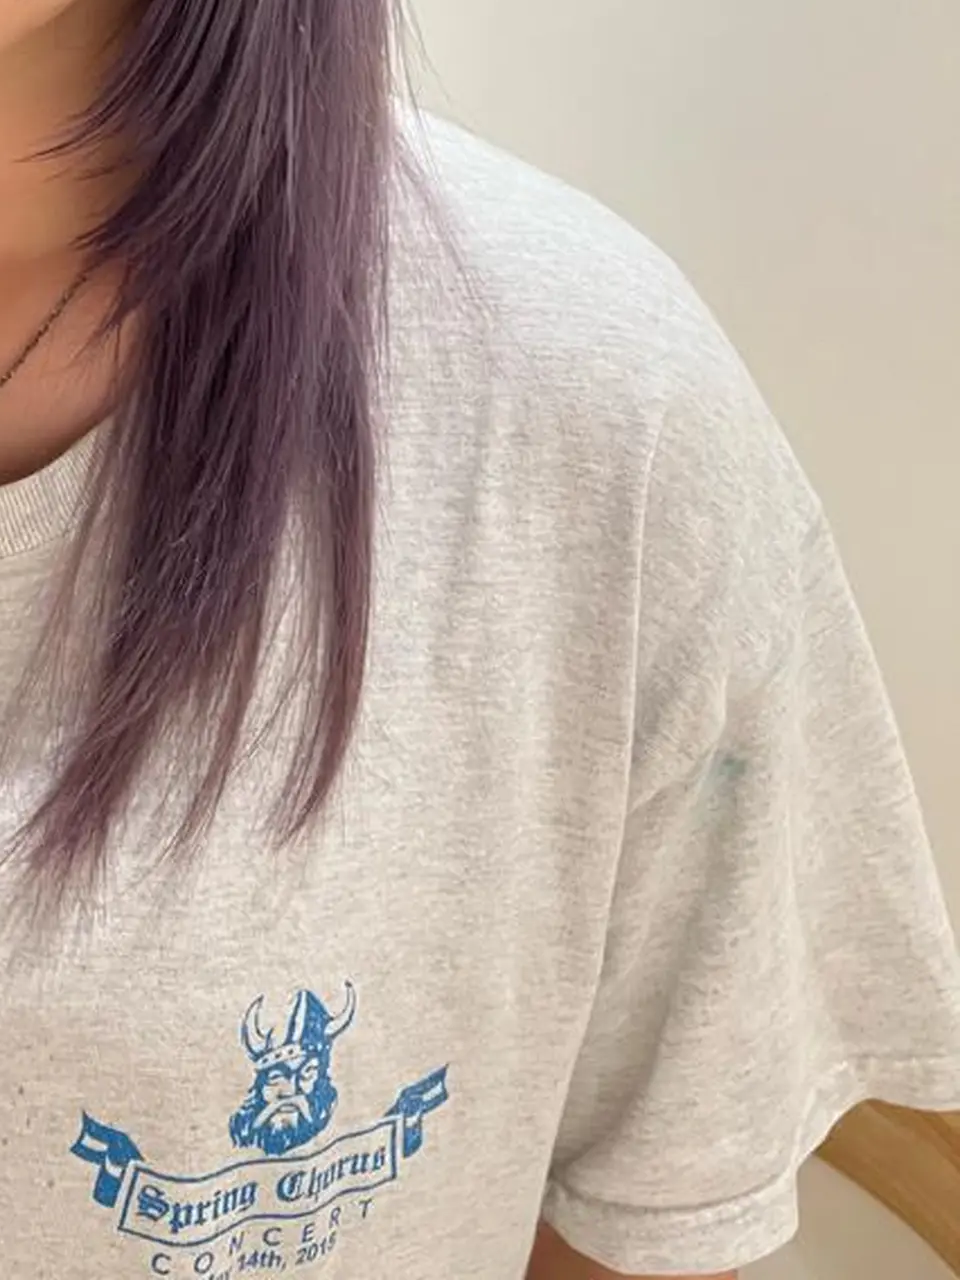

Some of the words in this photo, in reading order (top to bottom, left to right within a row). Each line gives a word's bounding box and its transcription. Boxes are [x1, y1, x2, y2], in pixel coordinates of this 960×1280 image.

[137, 1184, 257, 1234] Spring
[276, 1146, 386, 1202] Chorus
[151, 1198, 372, 1276] CONCERT
